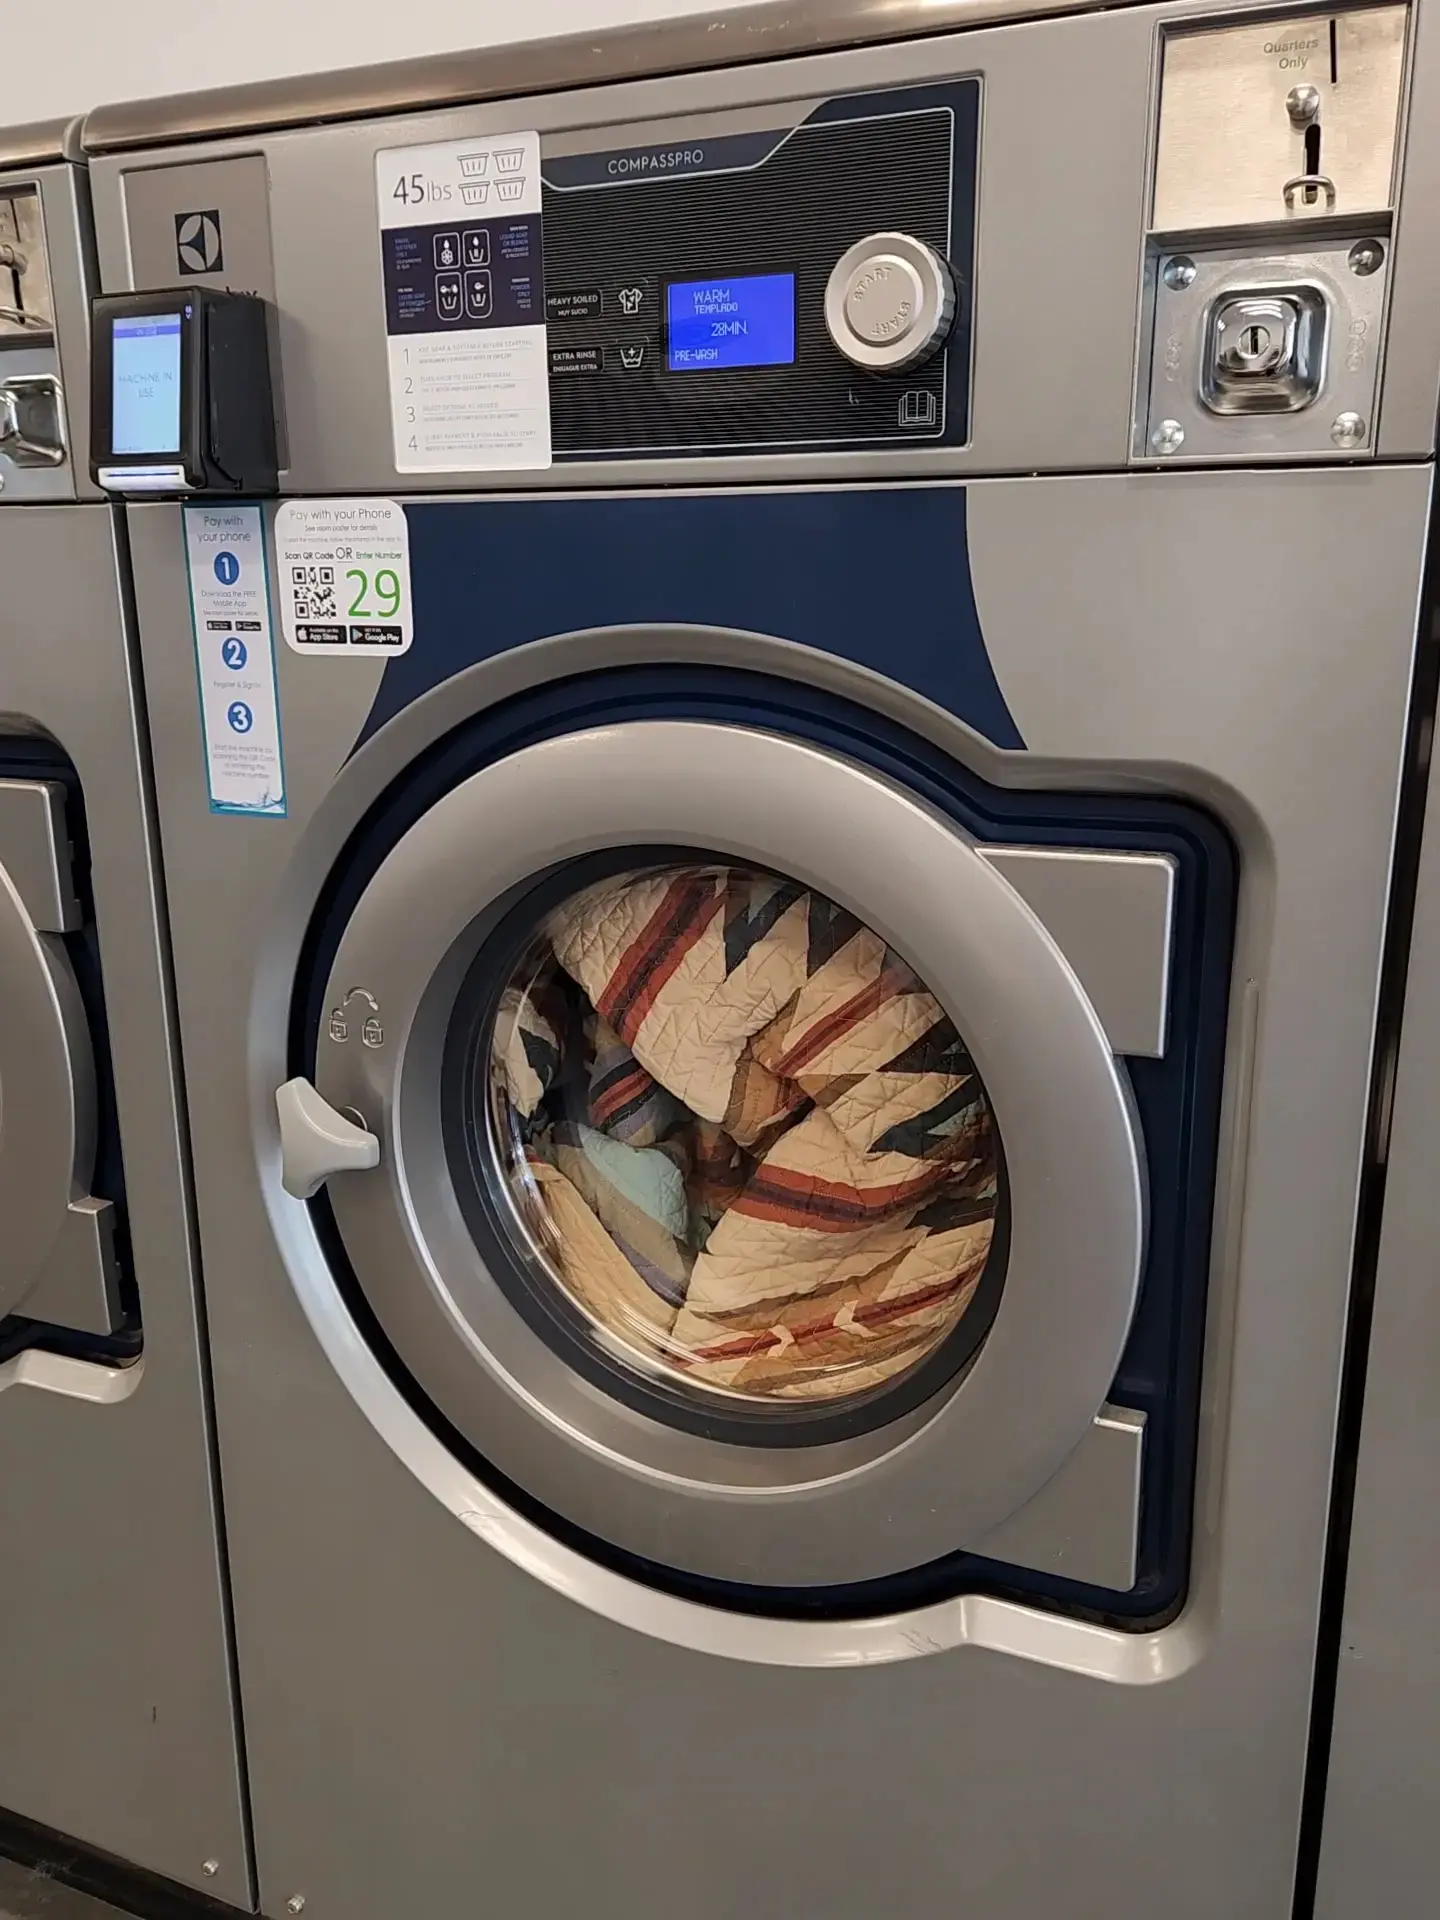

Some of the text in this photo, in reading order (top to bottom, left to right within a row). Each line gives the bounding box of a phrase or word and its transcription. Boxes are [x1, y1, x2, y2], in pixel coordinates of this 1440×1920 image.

[1263, 36, 1320, 55] Quarters
[1278, 55, 1309, 71] Only
[607, 149, 704, 175] COMPASSPRO
[393, 174, 452, 205] 45lbs
[854, 266, 892, 302] START
[547, 294, 598, 306] HEAVY SOILED
[693, 288, 730, 305] WARM
[694, 302, 738, 315] TEMPLADO
[871, 301, 911, 336] START
[403, 348, 409, 365] 1
[552, 350, 597, 361] EXTRA RINSE
[674, 348, 718, 362] PRE-WASH
[119, 371, 172, 384] MACHINE IN
[404, 377, 414, 394] 2
[138, 387, 154, 398] USE
[406, 406, 416, 423] 3
[408, 434, 418, 451] 4
[204, 516, 243, 528] Pay with
[289, 508, 392, 522] Pay with your Phone
[305, 524, 316, 532] See
[197, 532, 251, 544] your phone
[284, 547, 402, 560] Scan QR Code OR Enter Number
[221, 557, 230, 580] 1
[346, 569, 401, 618] 29
[310, 633, 338, 641] App Store
[365, 633, 400, 643] Google Play
[227, 640, 243, 665] 2
[232, 704, 249, 731] 3
